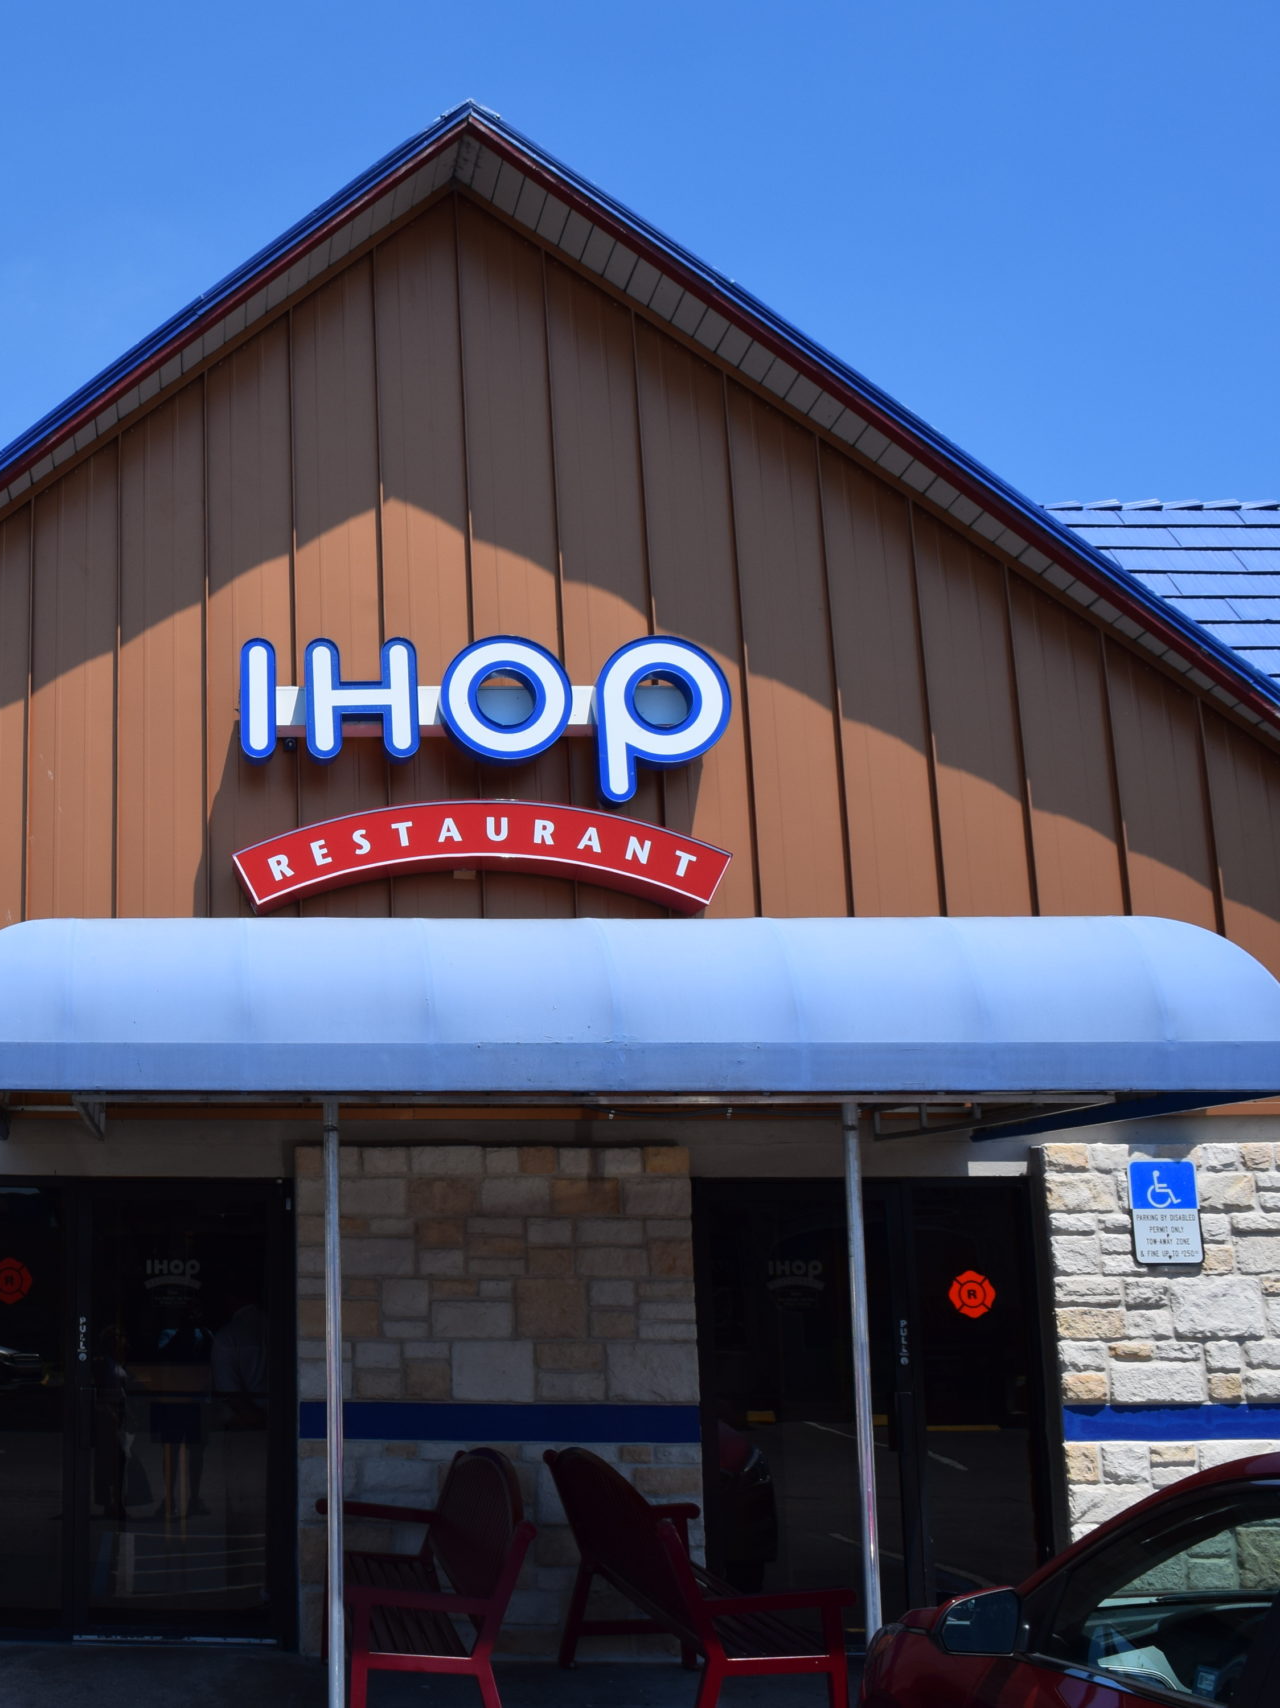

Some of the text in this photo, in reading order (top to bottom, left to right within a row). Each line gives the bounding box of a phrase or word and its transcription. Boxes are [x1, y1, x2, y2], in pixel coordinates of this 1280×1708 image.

[240, 635, 732, 806] IHOP
[267, 816, 697, 881] RESTAURANT
[1160, 1214, 1167, 1222] BY
[1148, 1225, 1184, 1233] PERMIT ONLY
[1175, 1237, 1191, 1246] ZONE
[1140, 1250, 1145, 1258] &
[1147, 1250, 1160, 1258] FINE
[1161, 1249, 1170, 1258] UP
[1172, 1250, 1180, 1258] TO
[145, 1258, 201, 1280] IHOP
[967, 1289, 977, 1299] R
[899, 1319, 908, 1352] PULL
